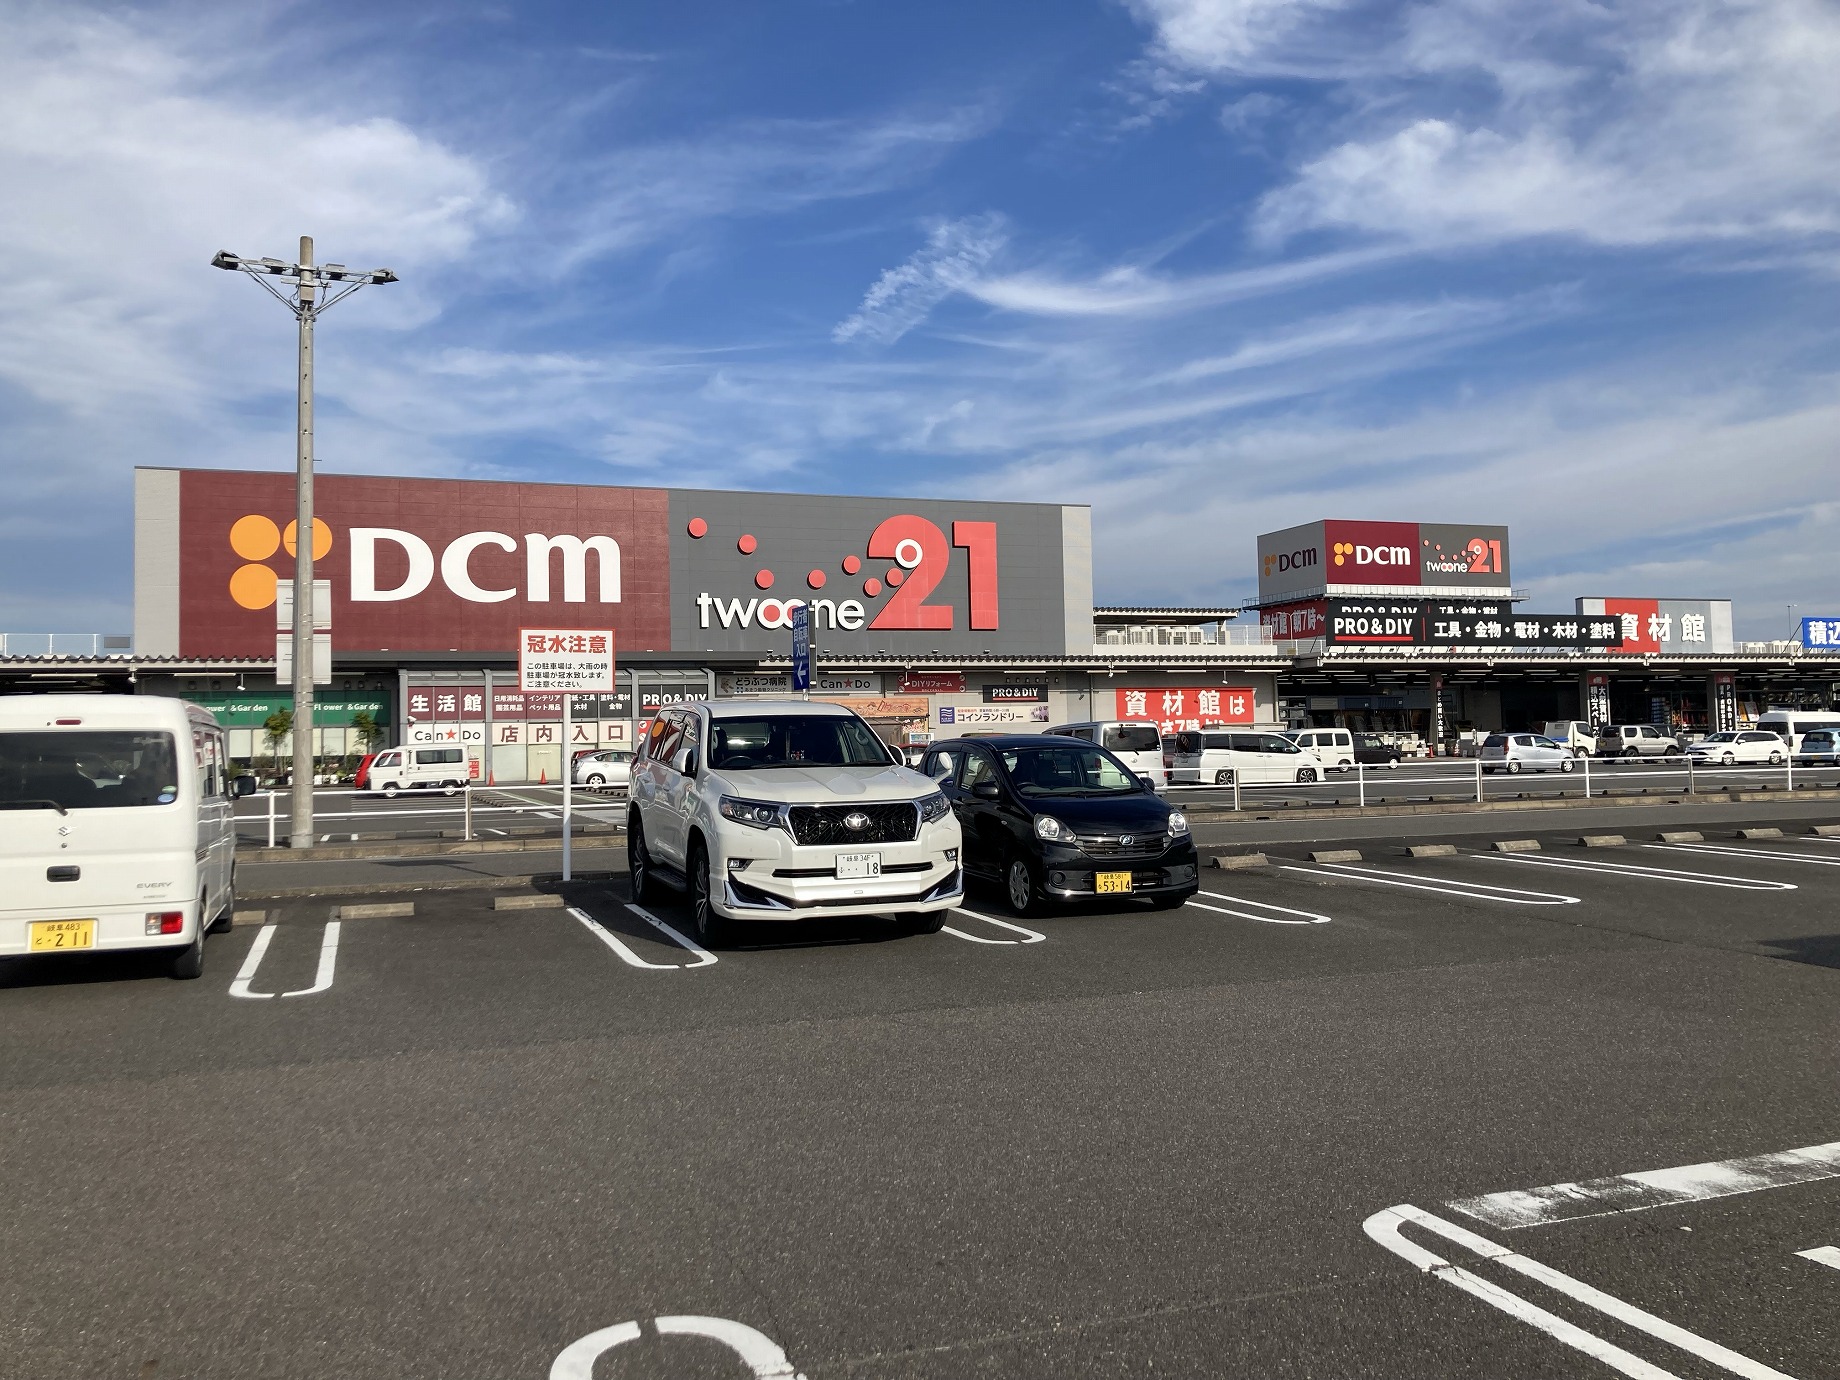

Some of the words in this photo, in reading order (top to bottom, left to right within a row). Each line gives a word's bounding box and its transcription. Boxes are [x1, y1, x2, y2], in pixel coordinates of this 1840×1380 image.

[1467, 538, 1502, 573] 21
[867, 514, 999, 631] 21
[1334, 618, 1413, 635] PRO&DIY
[1617, 612, 1705, 642] 資材館
[527, 635, 607, 653] 冠水注意
[735, 676, 787, 686] どうぶつ病院
[820, 680, 843, 689] Can
[855, 680, 871, 689] Do
[912, 680, 953, 688] DIYリフォーム
[992, 688, 1039, 697] PRO&DIY
[411, 694, 482, 712] 生活館
[570, 694, 596, 702] 紙・工具
[957, 713, 1024, 722] コインランドリー
[414, 731, 444, 741] Can
[462, 730, 482, 740] Do
[136, 881, 172, 889] EVERY
